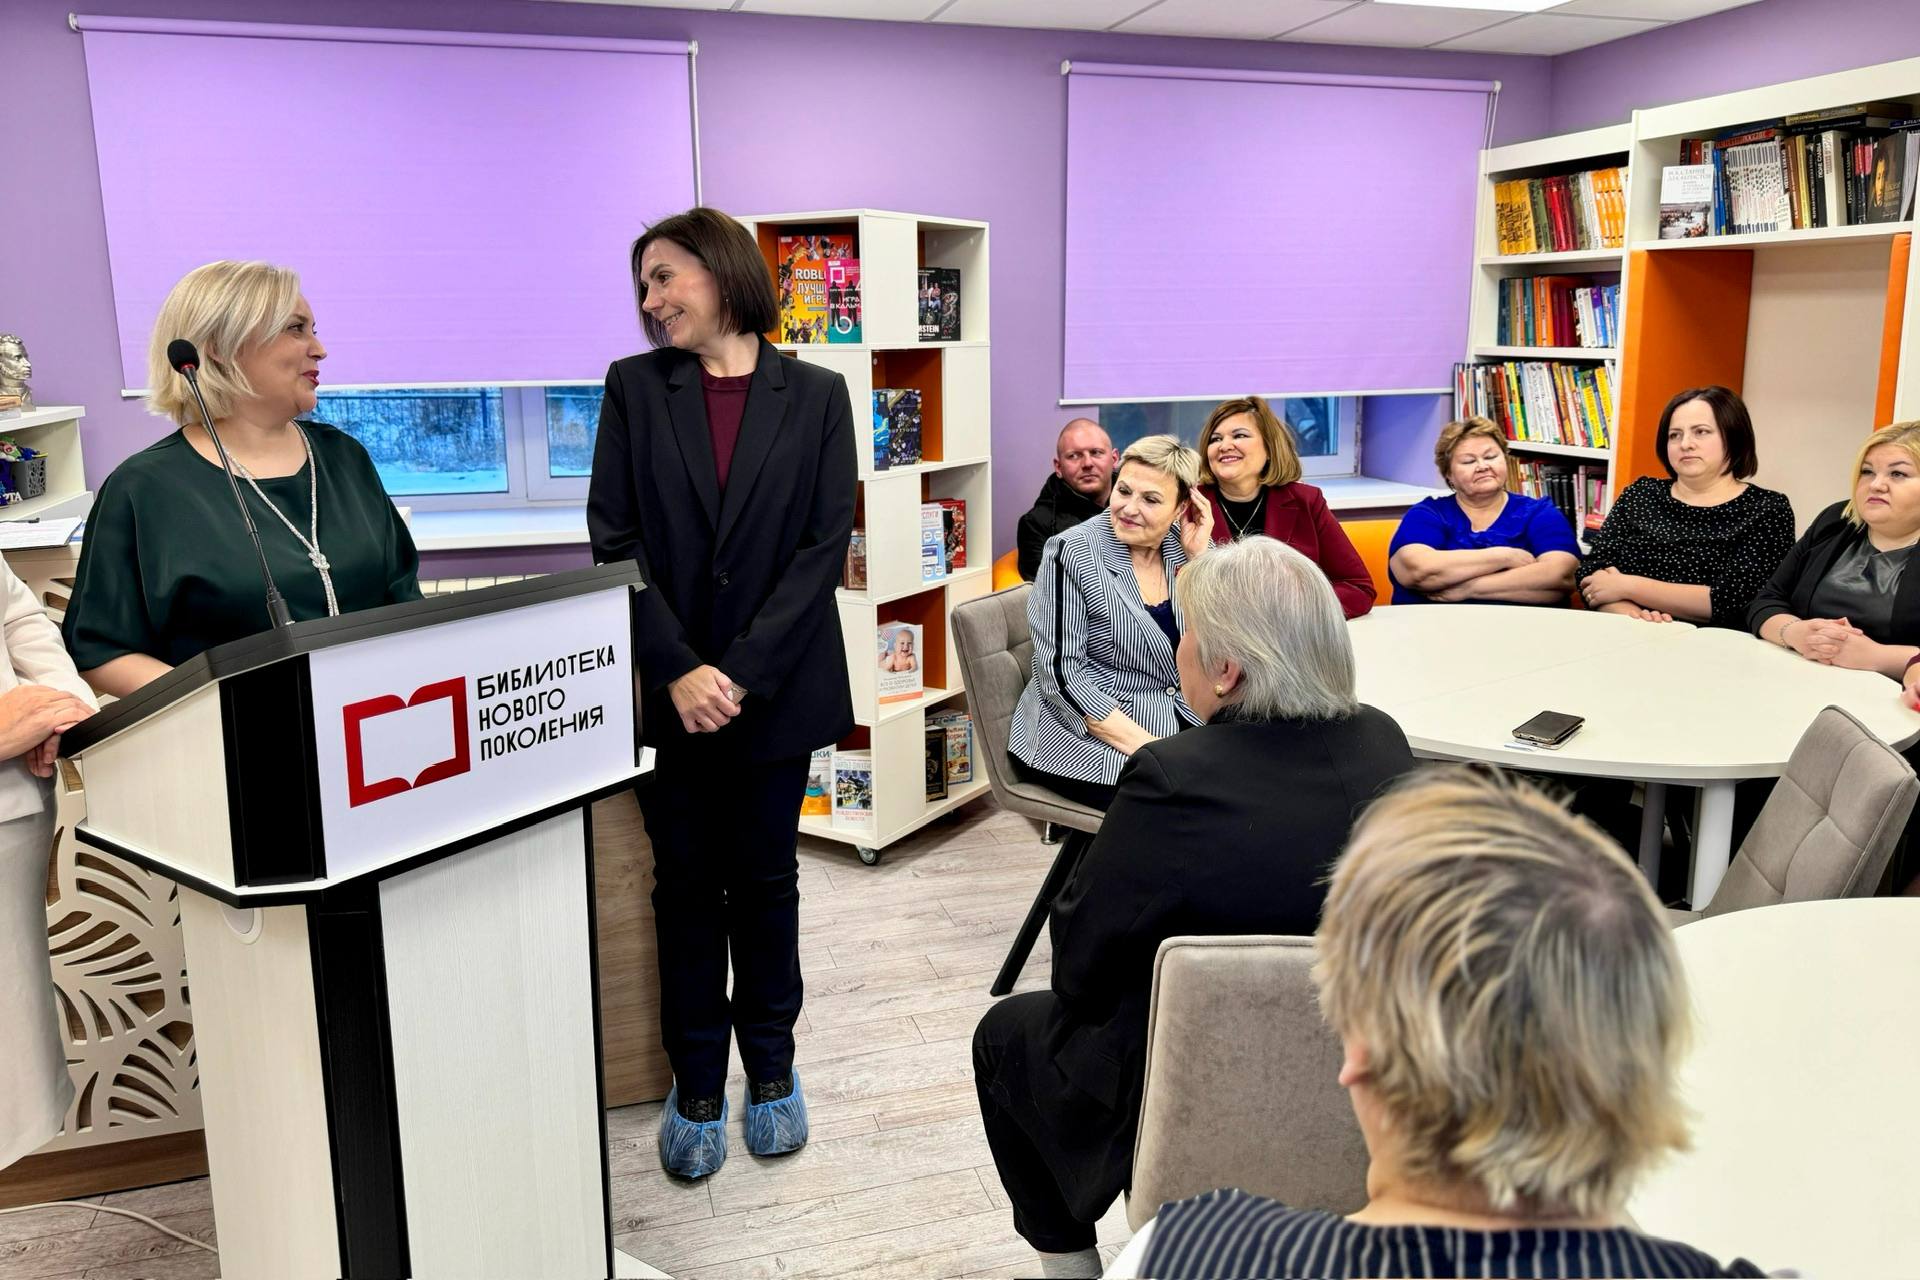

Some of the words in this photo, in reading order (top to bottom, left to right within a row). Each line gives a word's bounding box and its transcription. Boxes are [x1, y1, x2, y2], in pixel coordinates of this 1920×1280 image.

[477, 645, 615, 700] БИБЛИОТЕКА
[479, 688, 565, 731] НОВОГО
[480, 705, 603, 761] ПОКОЛЕНИЯ
